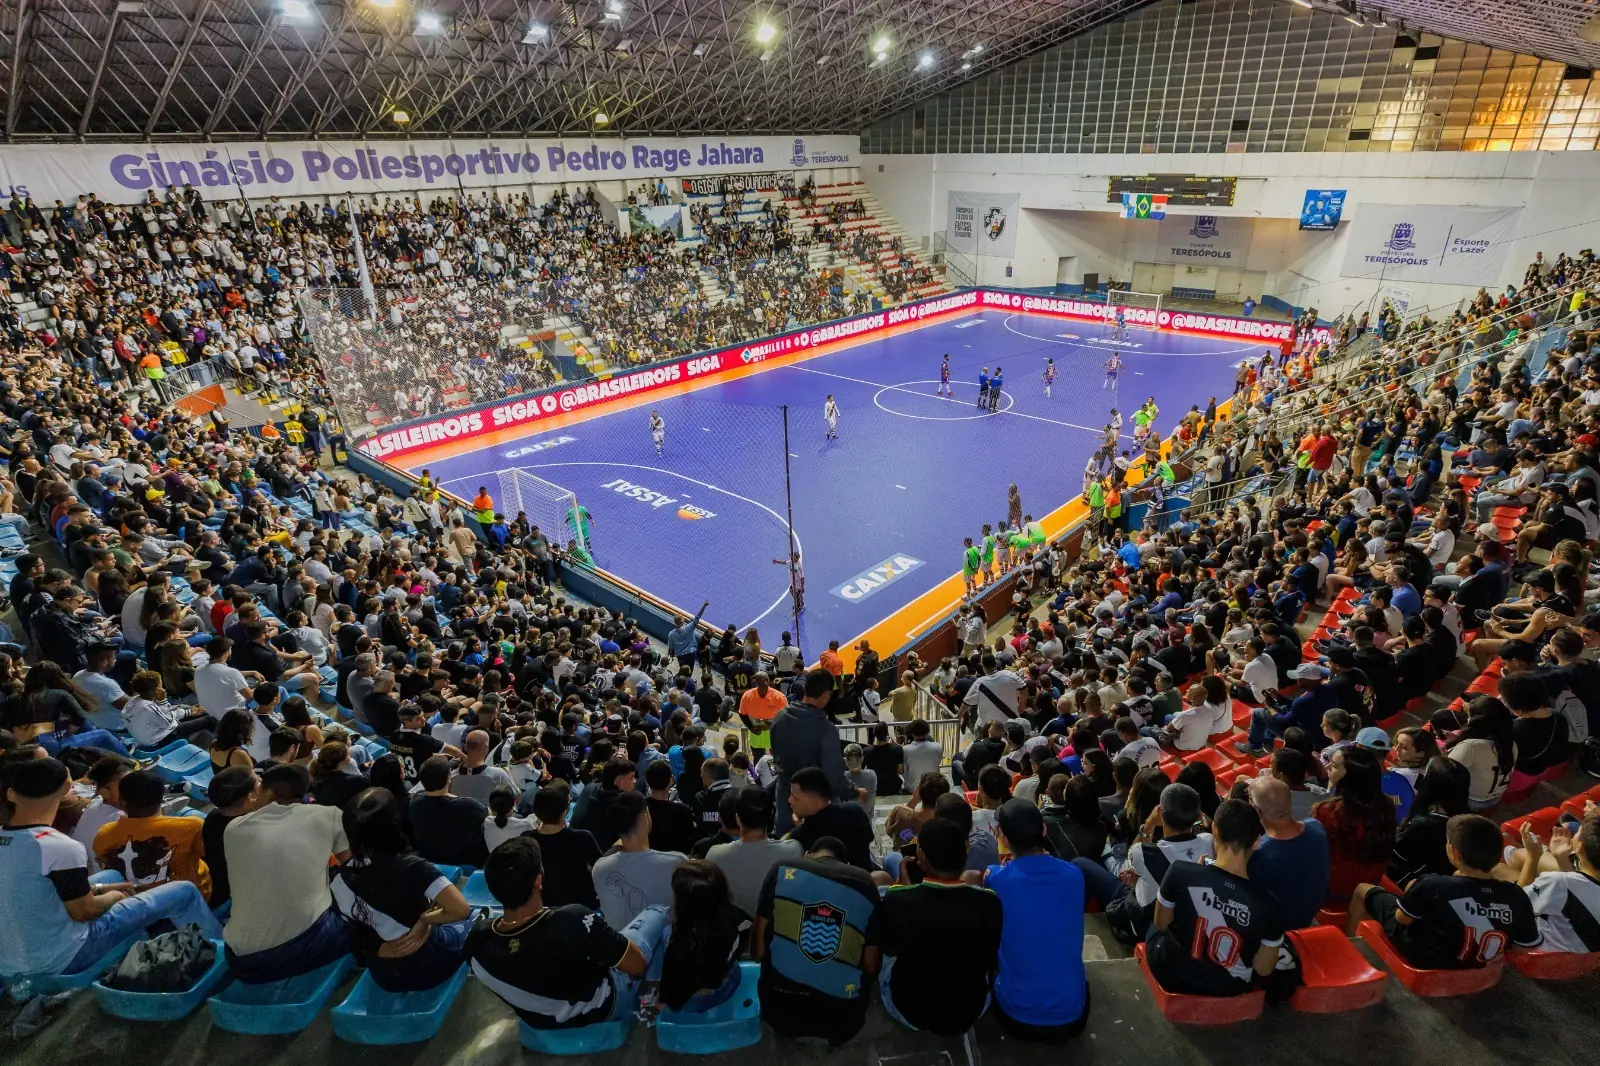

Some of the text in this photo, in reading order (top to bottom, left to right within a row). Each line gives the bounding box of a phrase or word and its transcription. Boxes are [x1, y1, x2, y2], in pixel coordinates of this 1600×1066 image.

[110, 142, 764, 190] Ginásio Poliesportivo Pedro Rage Jahara
[811, 154, 849, 163] TERESÓPOLIS
[1454, 238, 1490, 247] Esporte
[1460, 246, 1485, 254] Lazer
[1171, 247, 1231, 258] TERESÓPOLIS
[1365, 255, 1428, 265] TERESÓPOLIS
[888, 309, 909, 324] SIGA
[910, 307, 916, 318] O
[983, 292, 1010, 306] SIGA
[1012, 295, 1021, 307] O
[1124, 308, 1157, 323] SIGA
[1158, 310, 1170, 325] O
[492, 401, 540, 426] SIGA
[541, 396, 556, 412] O
[686, 355, 720, 376] SIGA
[505, 435, 577, 458] CAIXA
[840, 556, 919, 599] CAIXA
[734, 673, 748, 688] 10
[784, 868, 797, 880] K
[810, 914, 836, 924] OSKLEN
[1212, 893, 1251, 927] bmg
[1476, 902, 1512, 924] bmg
[1191, 914, 1243, 968] 10
[1457, 926, 1508, 961] 10
